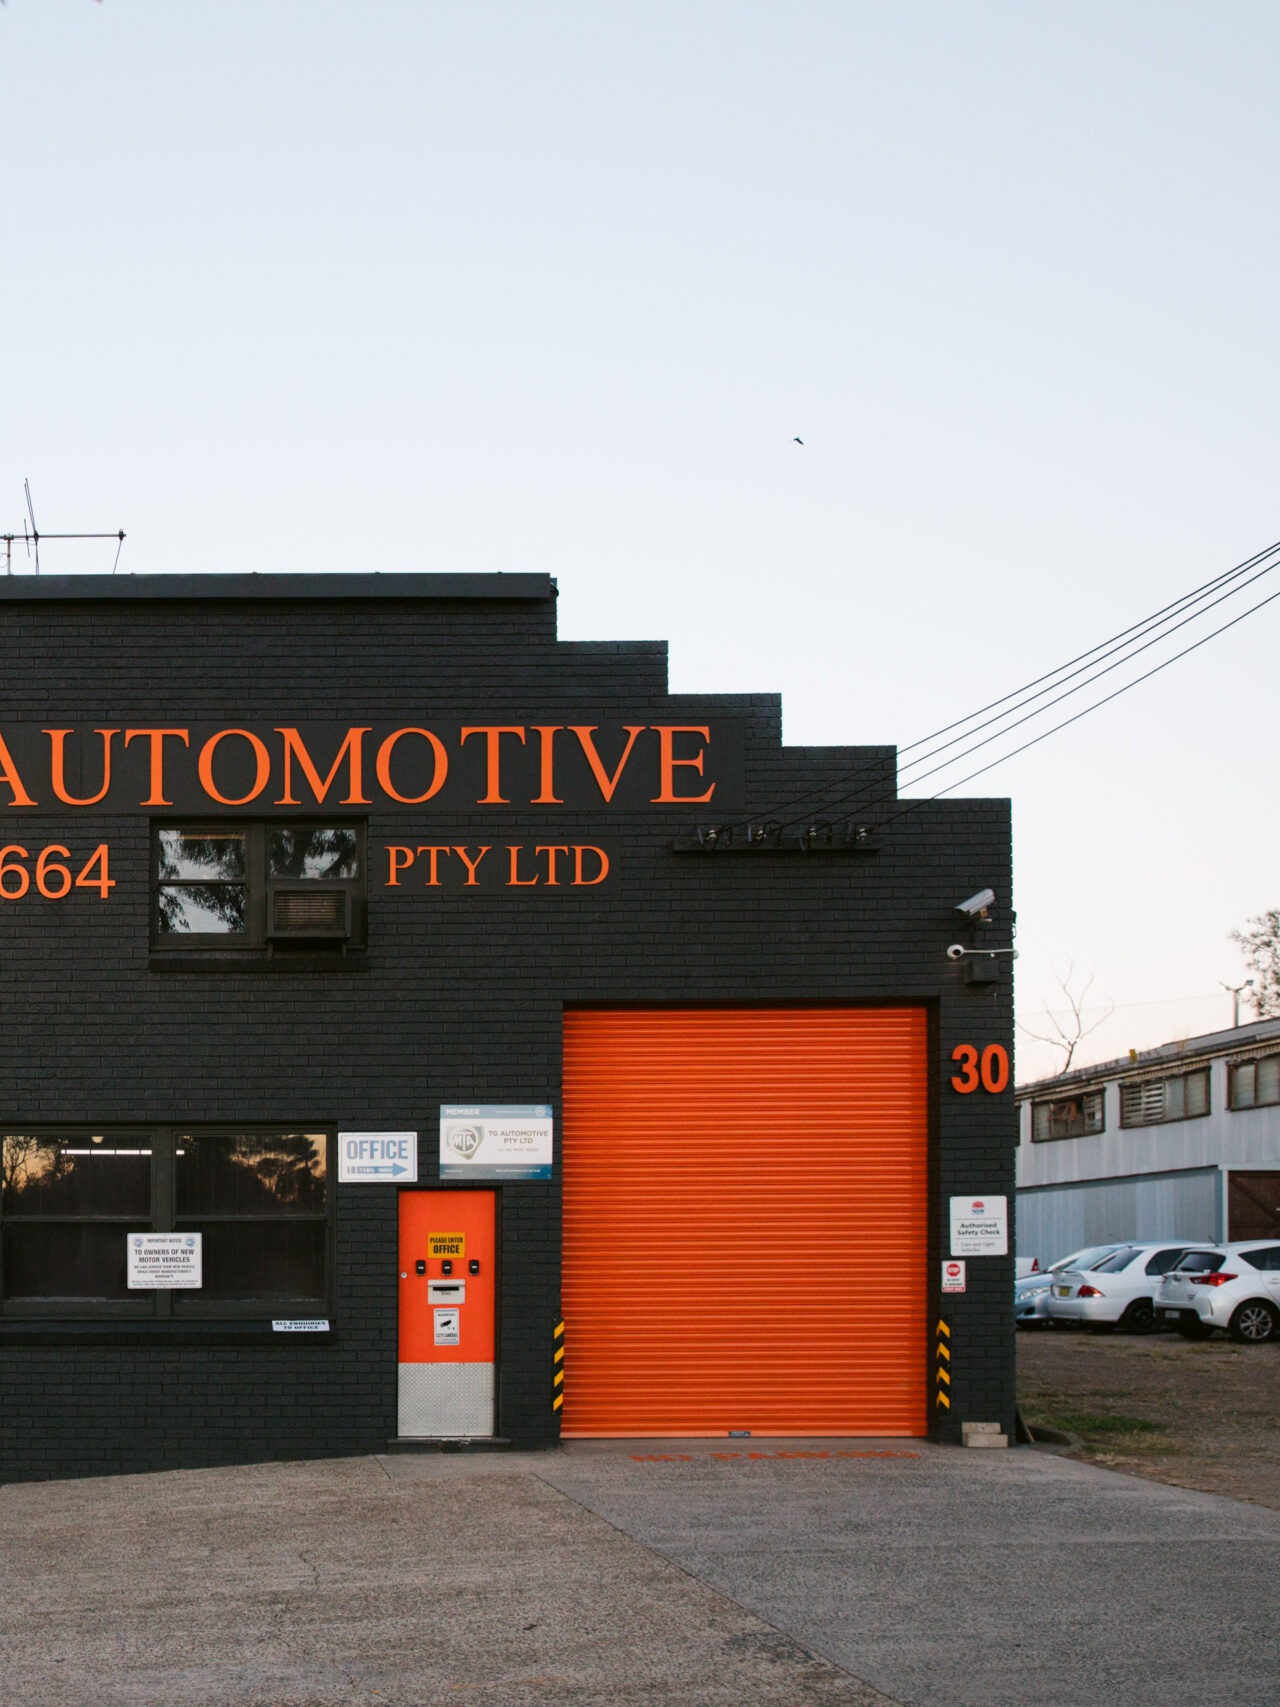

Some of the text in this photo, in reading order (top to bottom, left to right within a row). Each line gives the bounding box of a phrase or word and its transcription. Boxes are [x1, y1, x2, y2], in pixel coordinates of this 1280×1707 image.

[384, 846, 610, 886] PTY LTD
[951, 1044, 1009, 1094] 30
[446, 1108, 480, 1116] MEMBER
[346, 1140, 409, 1160] OFFICE
[433, 1245, 460, 1254] OFFICE
